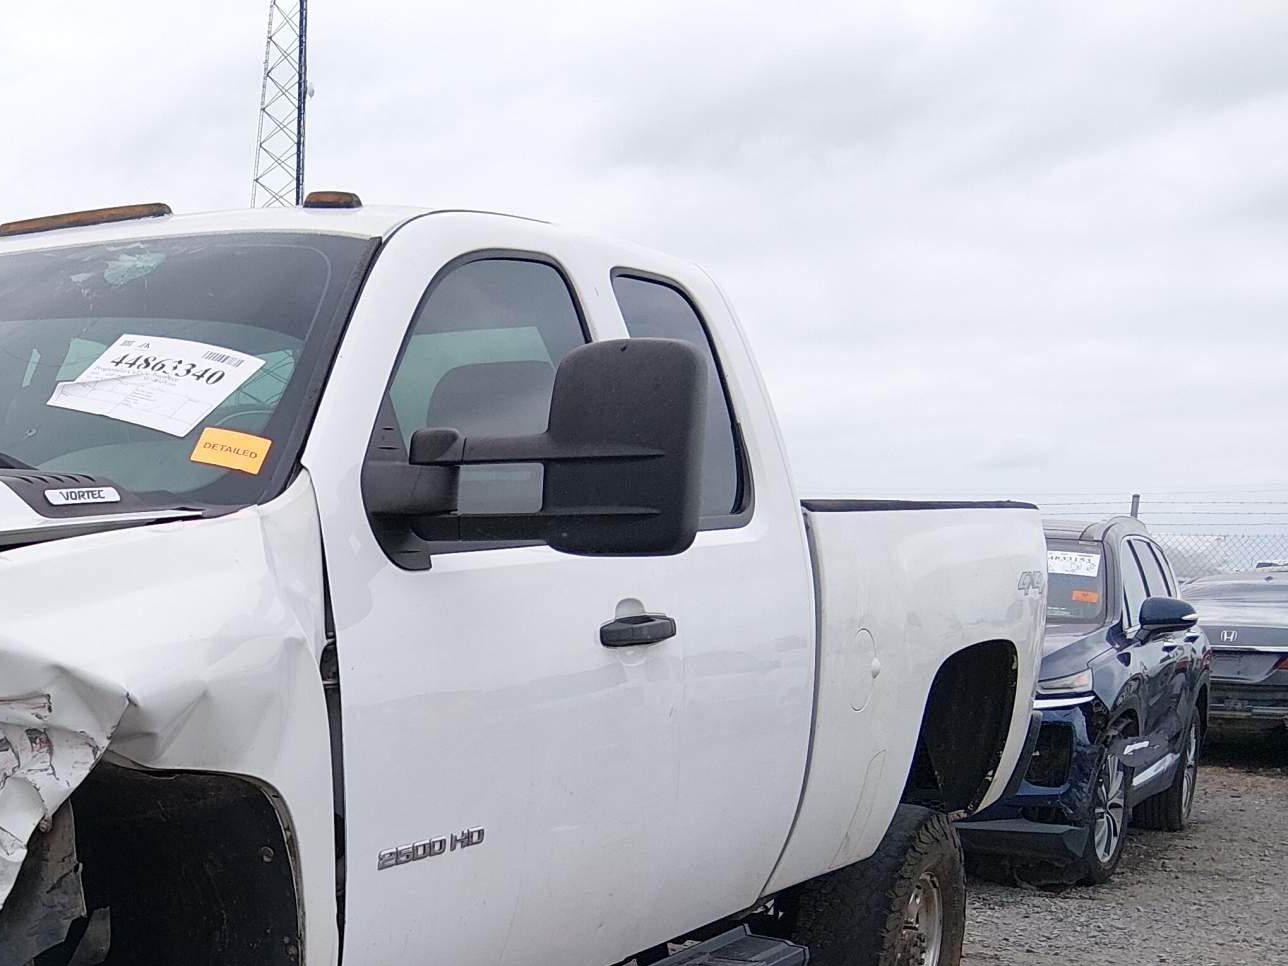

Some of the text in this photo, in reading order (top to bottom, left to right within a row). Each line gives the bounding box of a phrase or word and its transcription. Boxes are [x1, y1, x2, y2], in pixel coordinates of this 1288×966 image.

[111, 353, 226, 385] 44863340
[202, 441, 258, 460] DETAILED
[58, 489, 106, 501] VORTEC
[377, 825, 485, 871] 2500 HD
